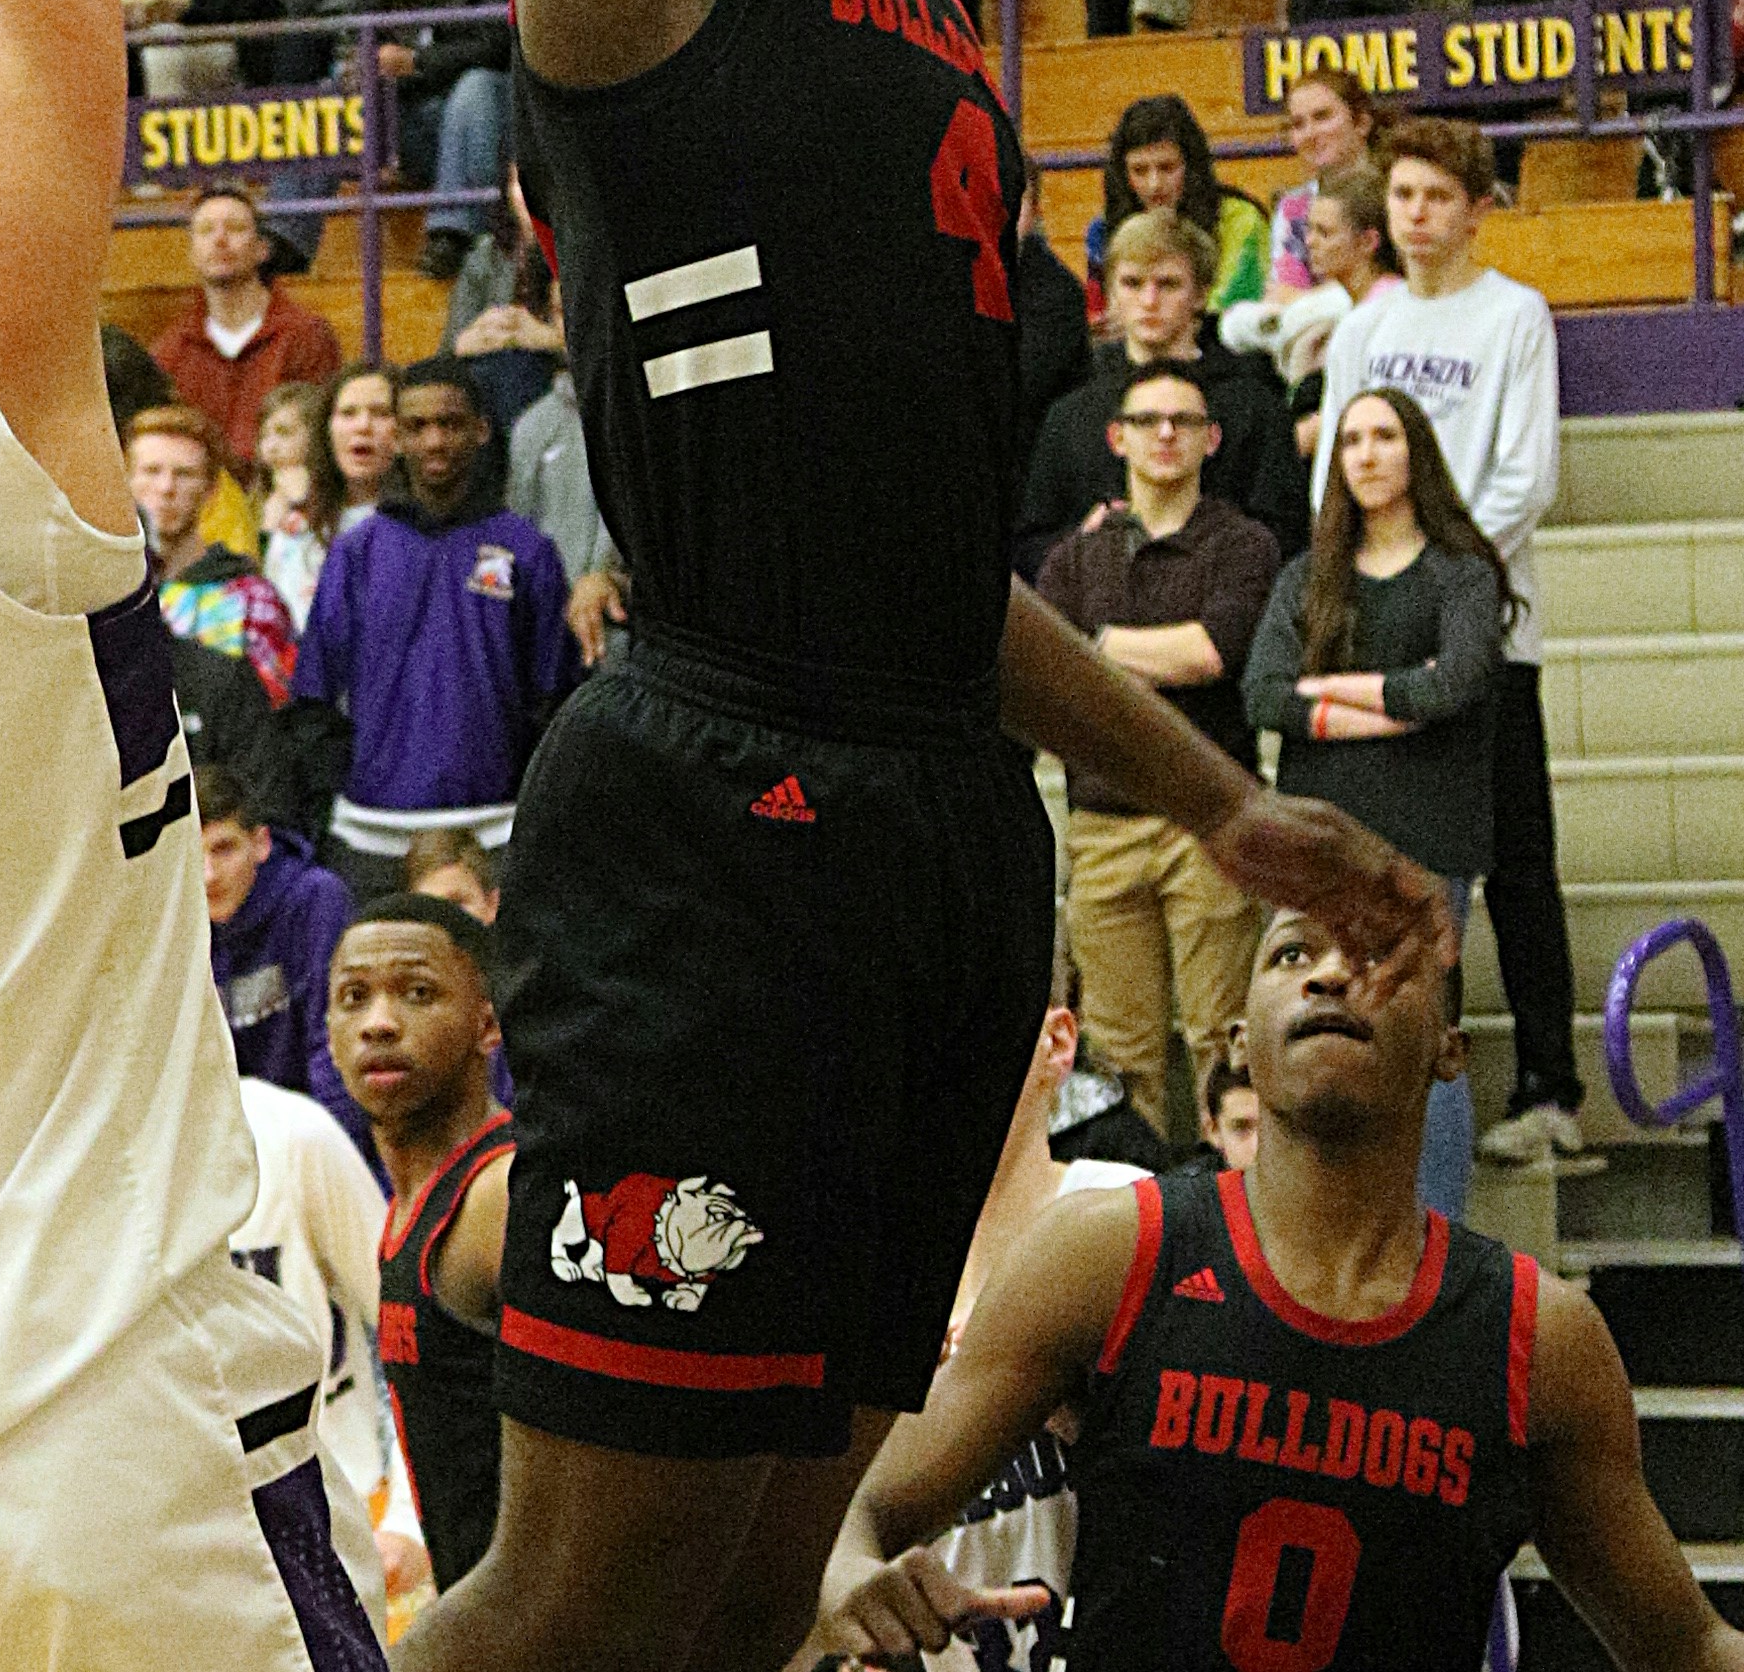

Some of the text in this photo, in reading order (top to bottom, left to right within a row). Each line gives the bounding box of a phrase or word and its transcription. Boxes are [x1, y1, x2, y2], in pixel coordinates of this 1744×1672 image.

[1443, 7, 1694, 88] STUDNTS
[139, 95, 364, 169] STUDENTS
[929, 98, 1014, 322] 4
[1149, 1368, 1475, 1507] BULLDOGS
